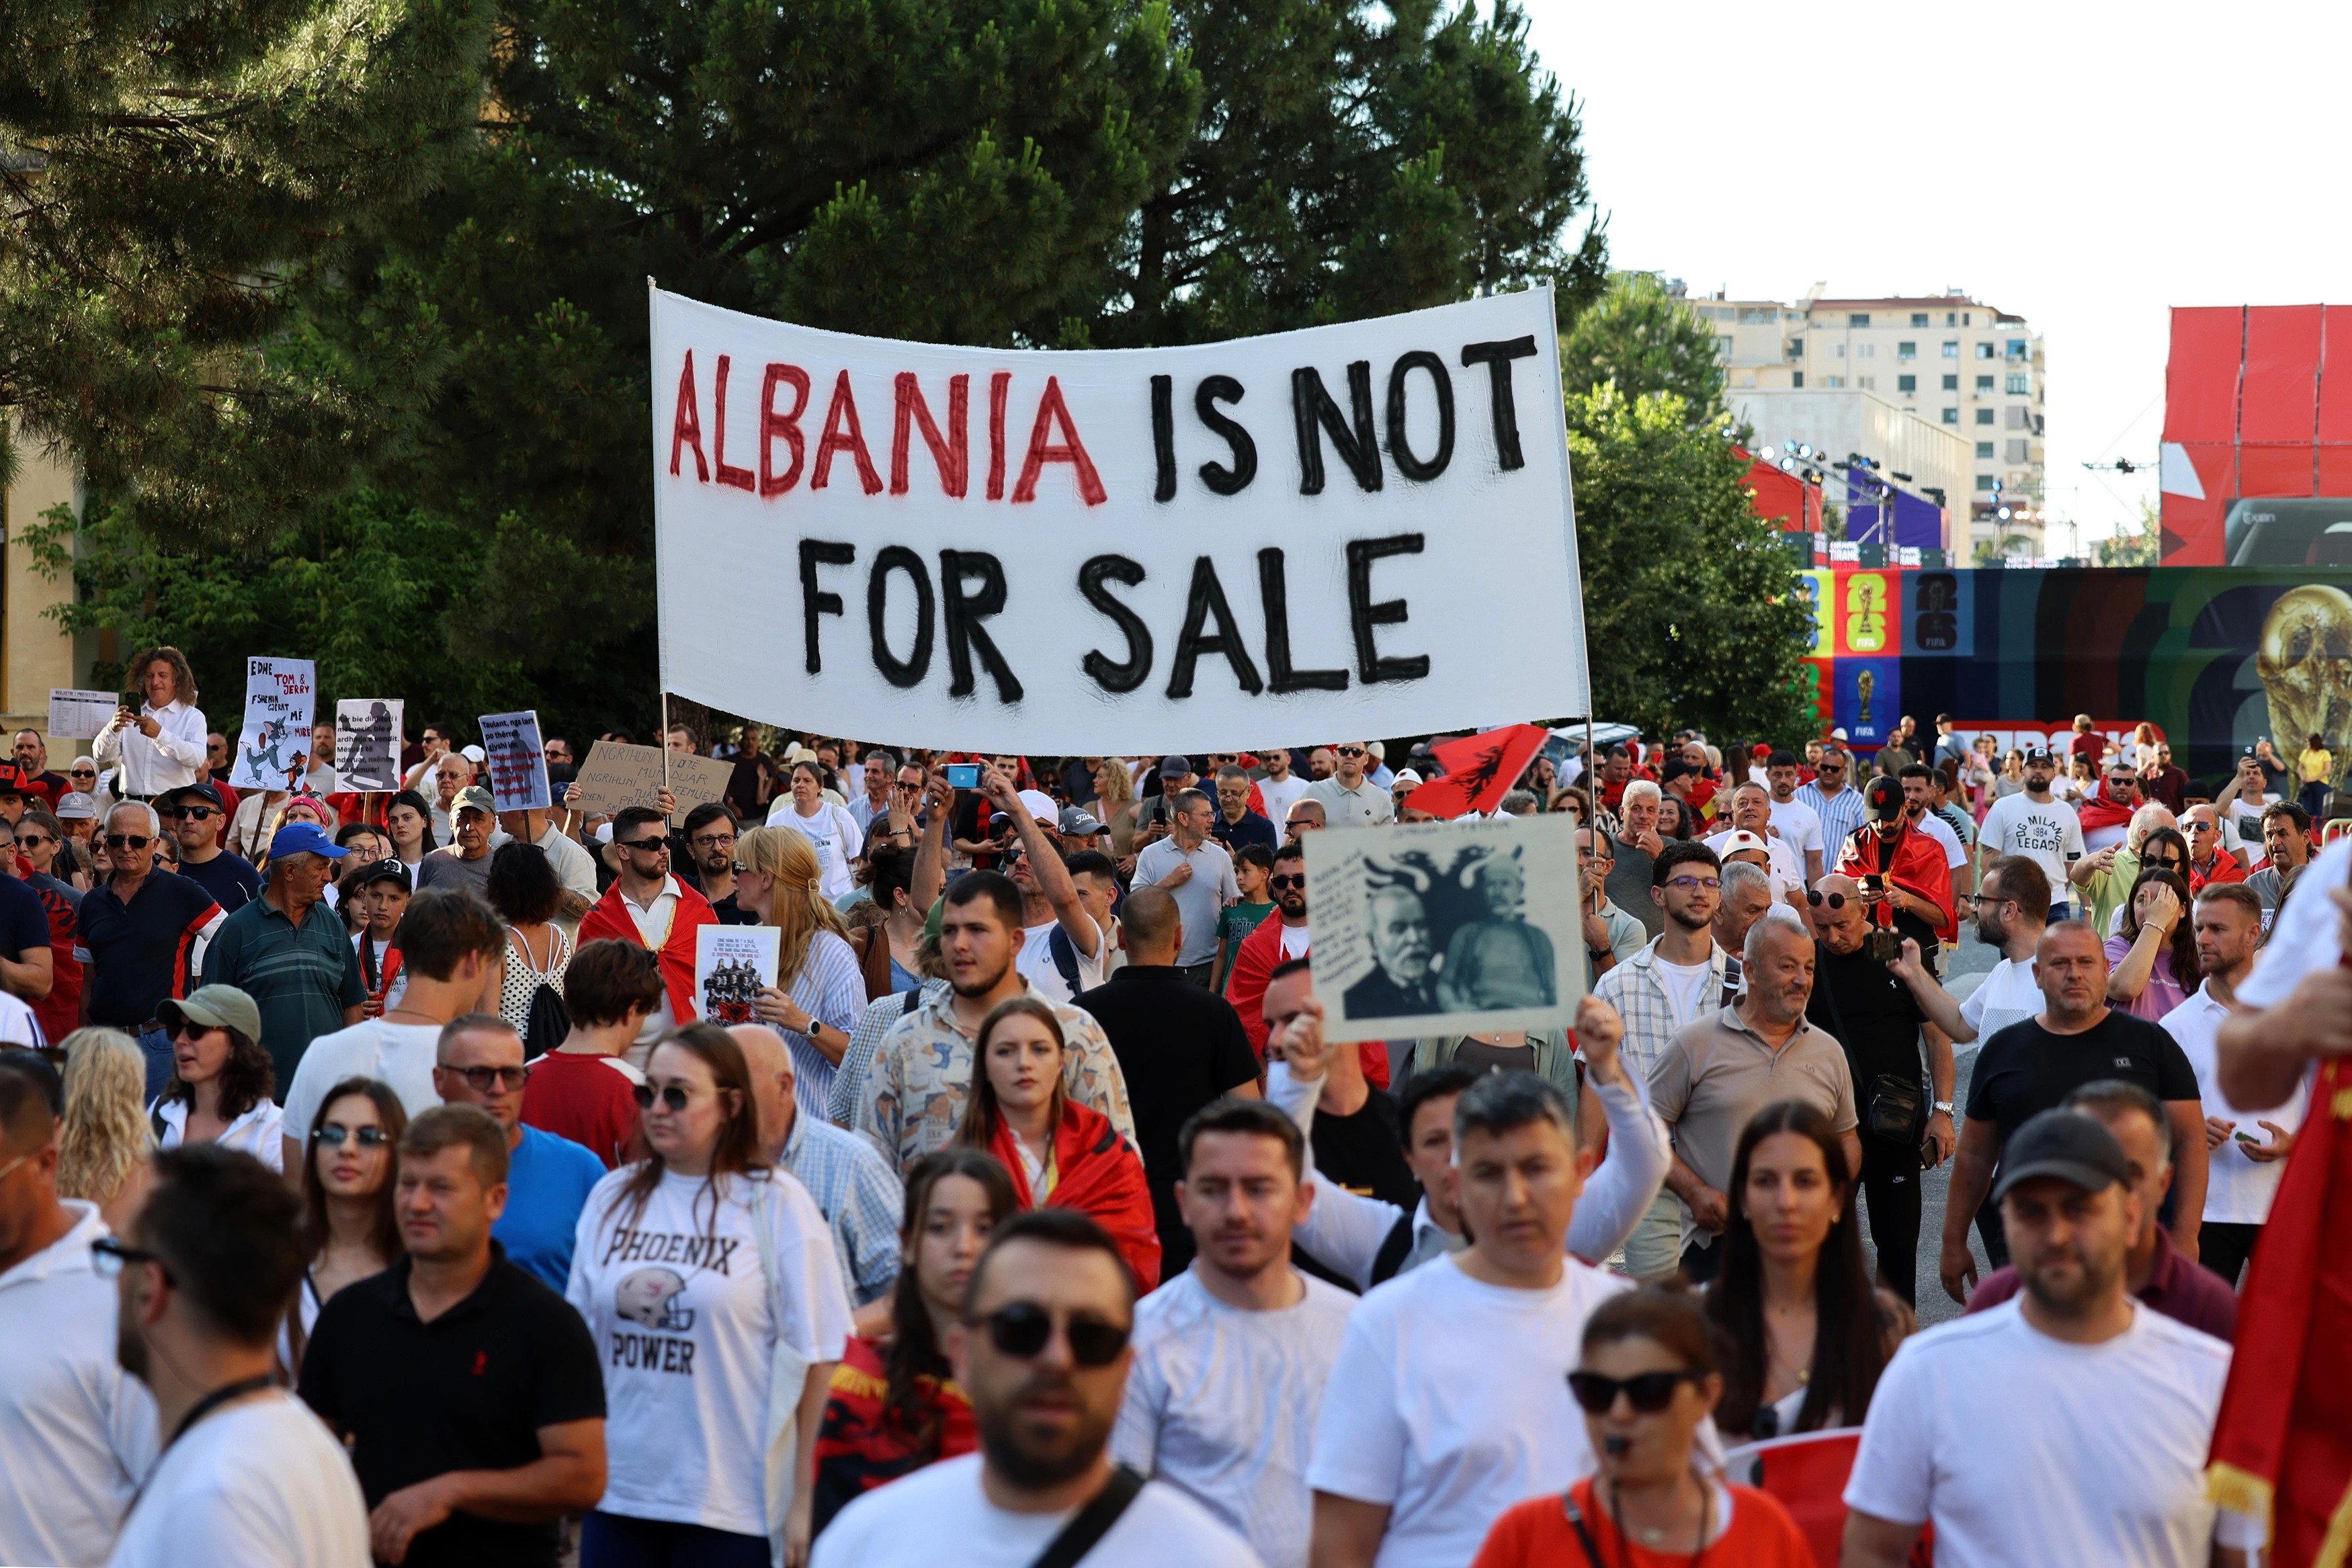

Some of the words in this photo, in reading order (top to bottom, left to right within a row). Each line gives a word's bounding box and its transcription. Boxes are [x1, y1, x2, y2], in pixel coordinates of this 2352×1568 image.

[669, 348, 1107, 507] ALBANIA
[1150, 374, 1258, 503] IS
[1291, 334, 1538, 495] NOT
[799, 538, 1024, 703] FOR
[1079, 532, 1431, 699] SALE
[1856, 638, 1876, 648] FIFA
[1925, 638, 1946, 648] FIFA
[251, 660, 273, 676] EDHE
[274, 673, 295, 686] TOM
[299, 673, 306, 685] &
[283, 685, 310, 695] JERRY
[290, 708, 303, 722] MË
[482, 720, 509, 728] Taulant,
[510, 719, 521, 727] nga
[294, 726, 310, 738] MIRË
[486, 733, 494, 741] po
[1855, 726, 1875, 737] FIFA
[488, 742, 507, 752] gjyshi
[596, 746, 657, 764] NGRIHUNI
[586, 773, 638, 787] NGRIHUNI
[581, 792, 606, 802] HYENI
[2016, 823, 2027, 838] DG
[2027, 815, 2062, 842] MILANO
[2033, 828, 2048, 838] 1984
[2017, 838, 2060, 853] LEGACY
[603, 1227, 739, 1276] PHOENIX
[612, 1332, 695, 1376] POWER
